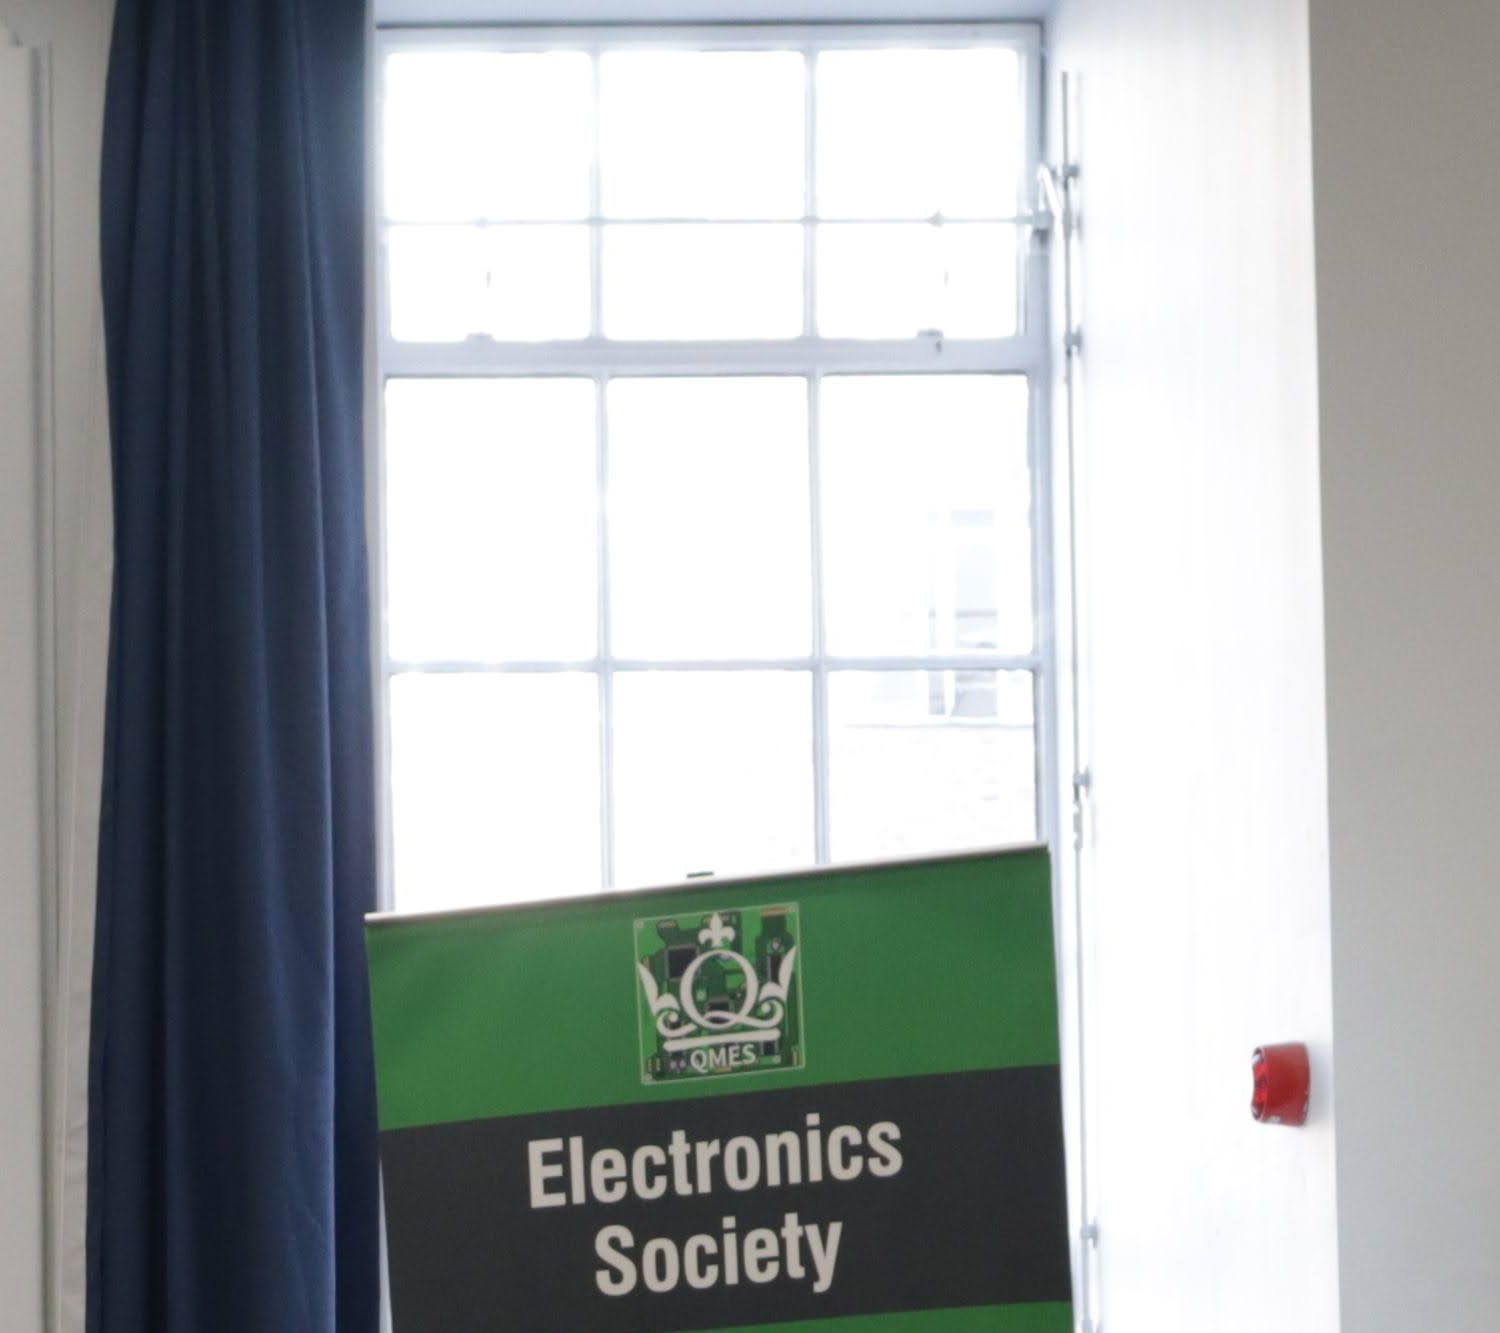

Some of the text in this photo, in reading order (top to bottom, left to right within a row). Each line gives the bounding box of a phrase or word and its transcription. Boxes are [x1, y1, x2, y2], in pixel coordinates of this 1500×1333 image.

[690, 1043, 756, 1073] QMES
[528, 1112, 903, 1209] Electronics
[595, 1213, 843, 1296] Society
